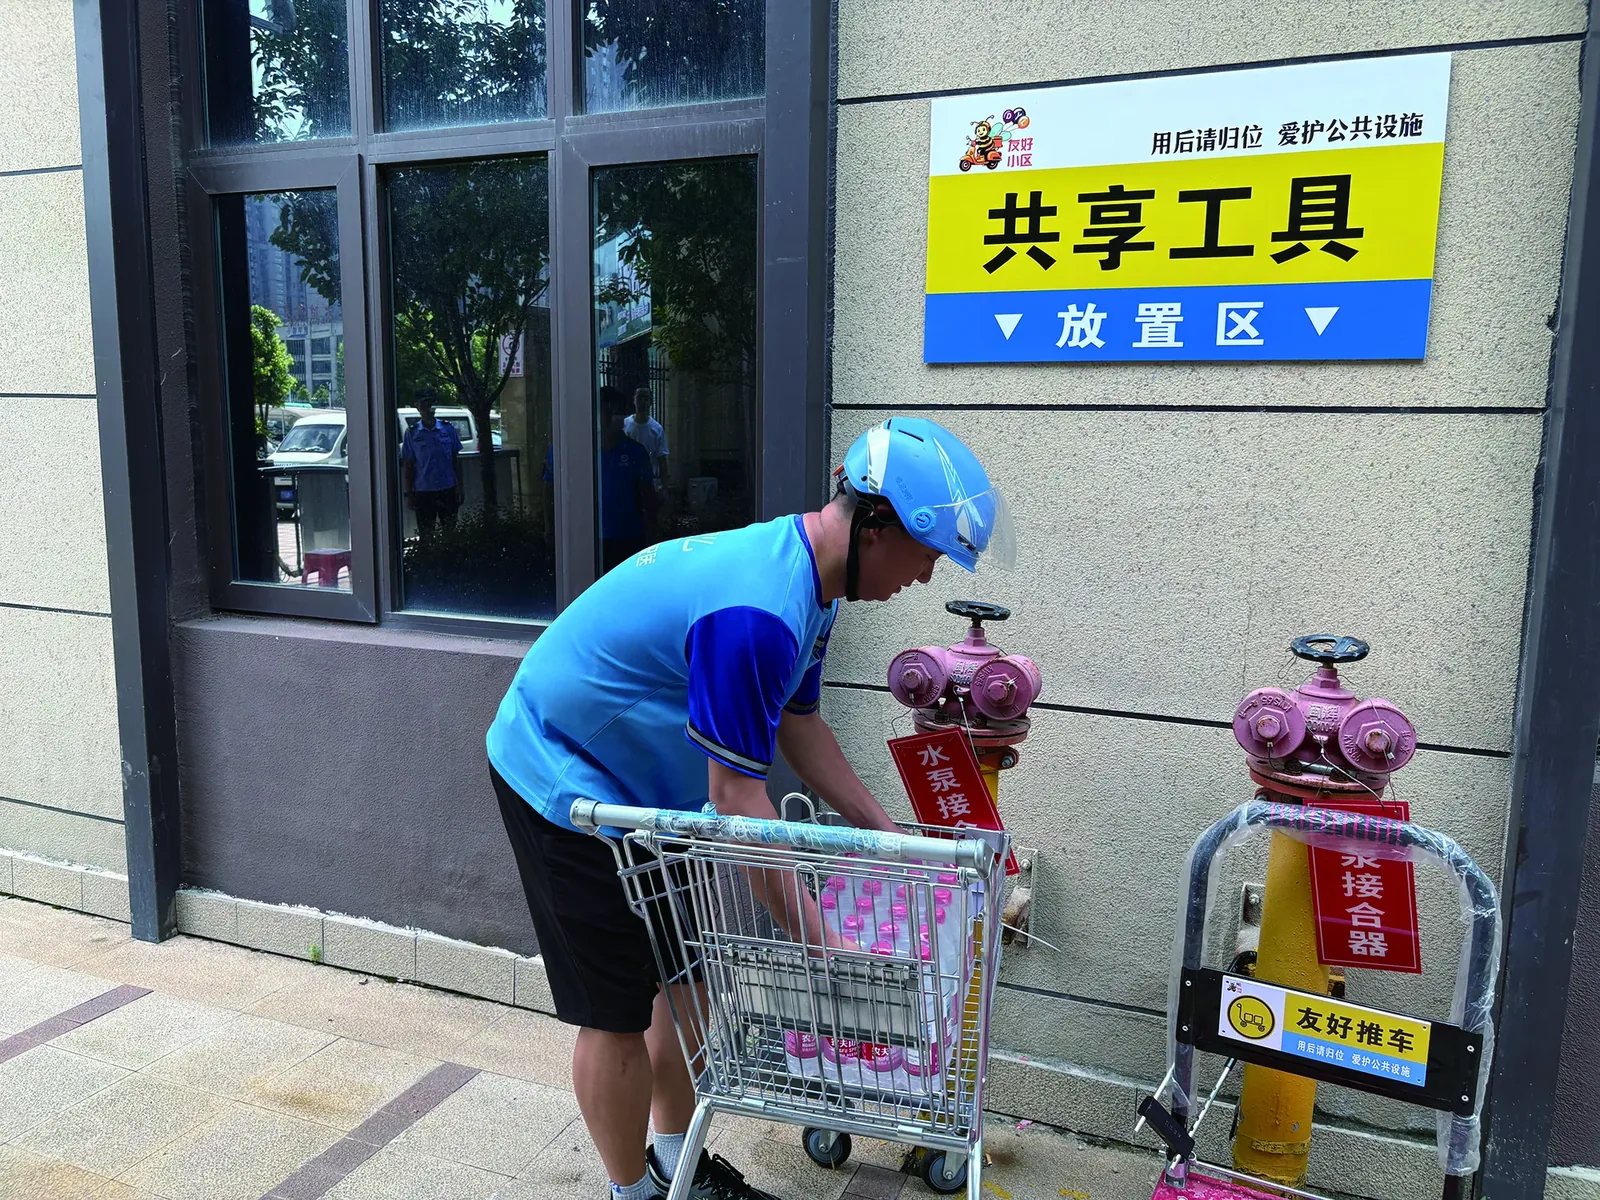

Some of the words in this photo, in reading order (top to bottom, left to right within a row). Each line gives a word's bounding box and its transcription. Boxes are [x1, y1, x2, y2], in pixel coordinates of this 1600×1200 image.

[1007, 137, 1033, 153] 友好
[1151, 124, 1263, 155] 用后请归位
[1277, 112, 1424, 146] 爱护公共设施
[1007, 153, 1033, 168] 小区
[982, 174, 1365, 274] 共享工具
[1056, 301, 1265, 349] 放置区
[1296, 1006, 1414, 1054] 友好推车
[1296, 1040, 1345, 1061] 用后请归位
[1351, 1053, 1411, 1078] 爱护公共设施
